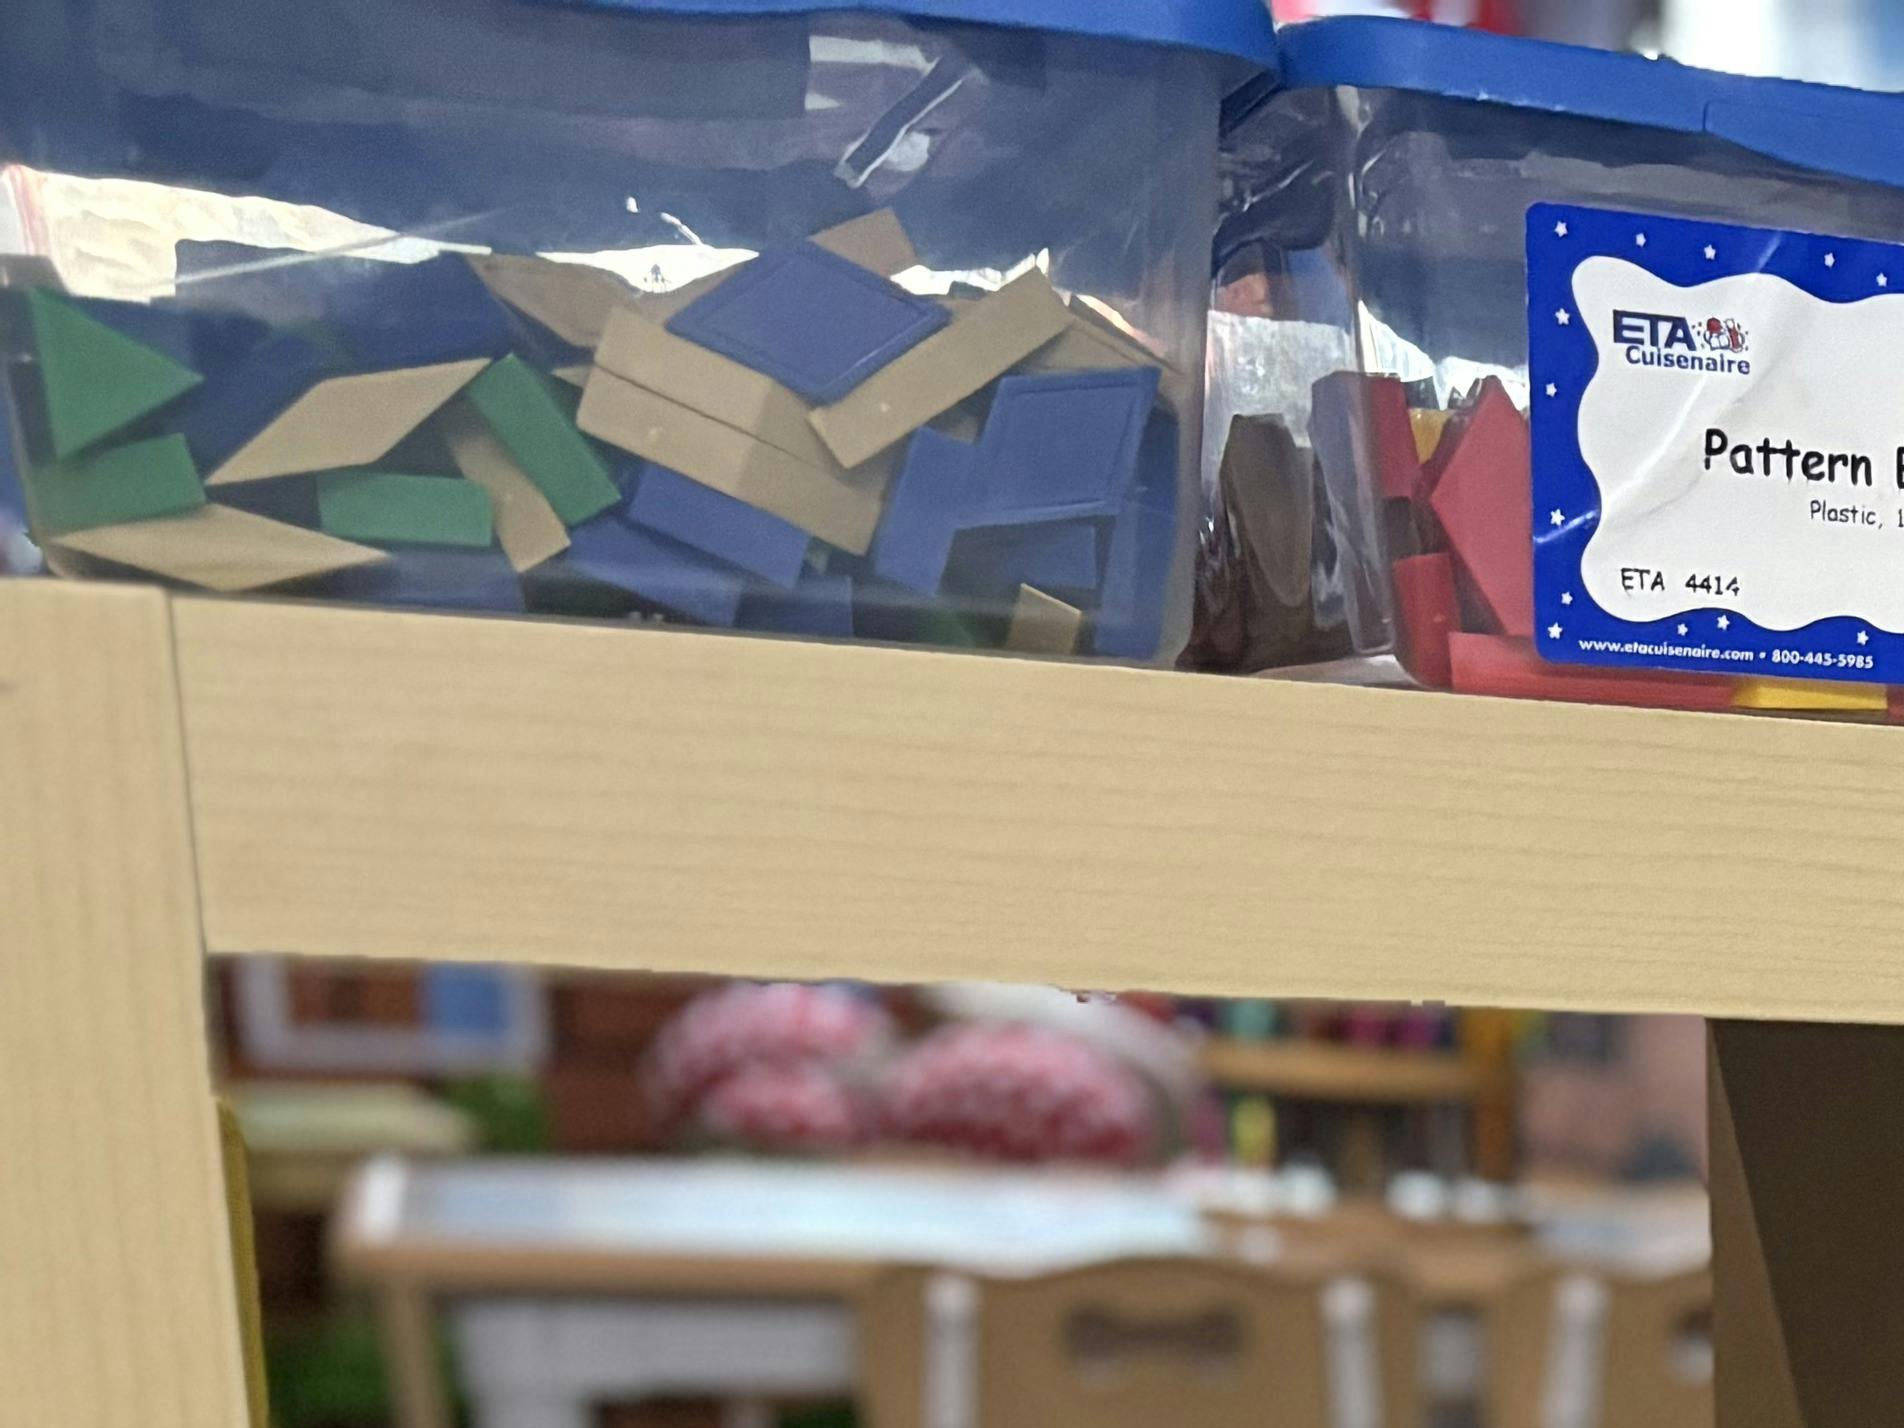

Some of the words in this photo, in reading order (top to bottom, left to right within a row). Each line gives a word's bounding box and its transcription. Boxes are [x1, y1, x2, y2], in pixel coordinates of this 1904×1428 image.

[1612, 309, 1697, 351] ETA
[1625, 345, 1750, 375] Cuisenaire
[1702, 428, 1873, 488] Pattern
[1810, 499, 1884, 530] Plastic,
[1620, 567, 1666, 592] ETA
[1684, 574, 1740, 597] 4414
[1578, 639, 1754, 662] www.etacuisenaire.com
[1771, 648, 1874, 669] 800-445-5985
